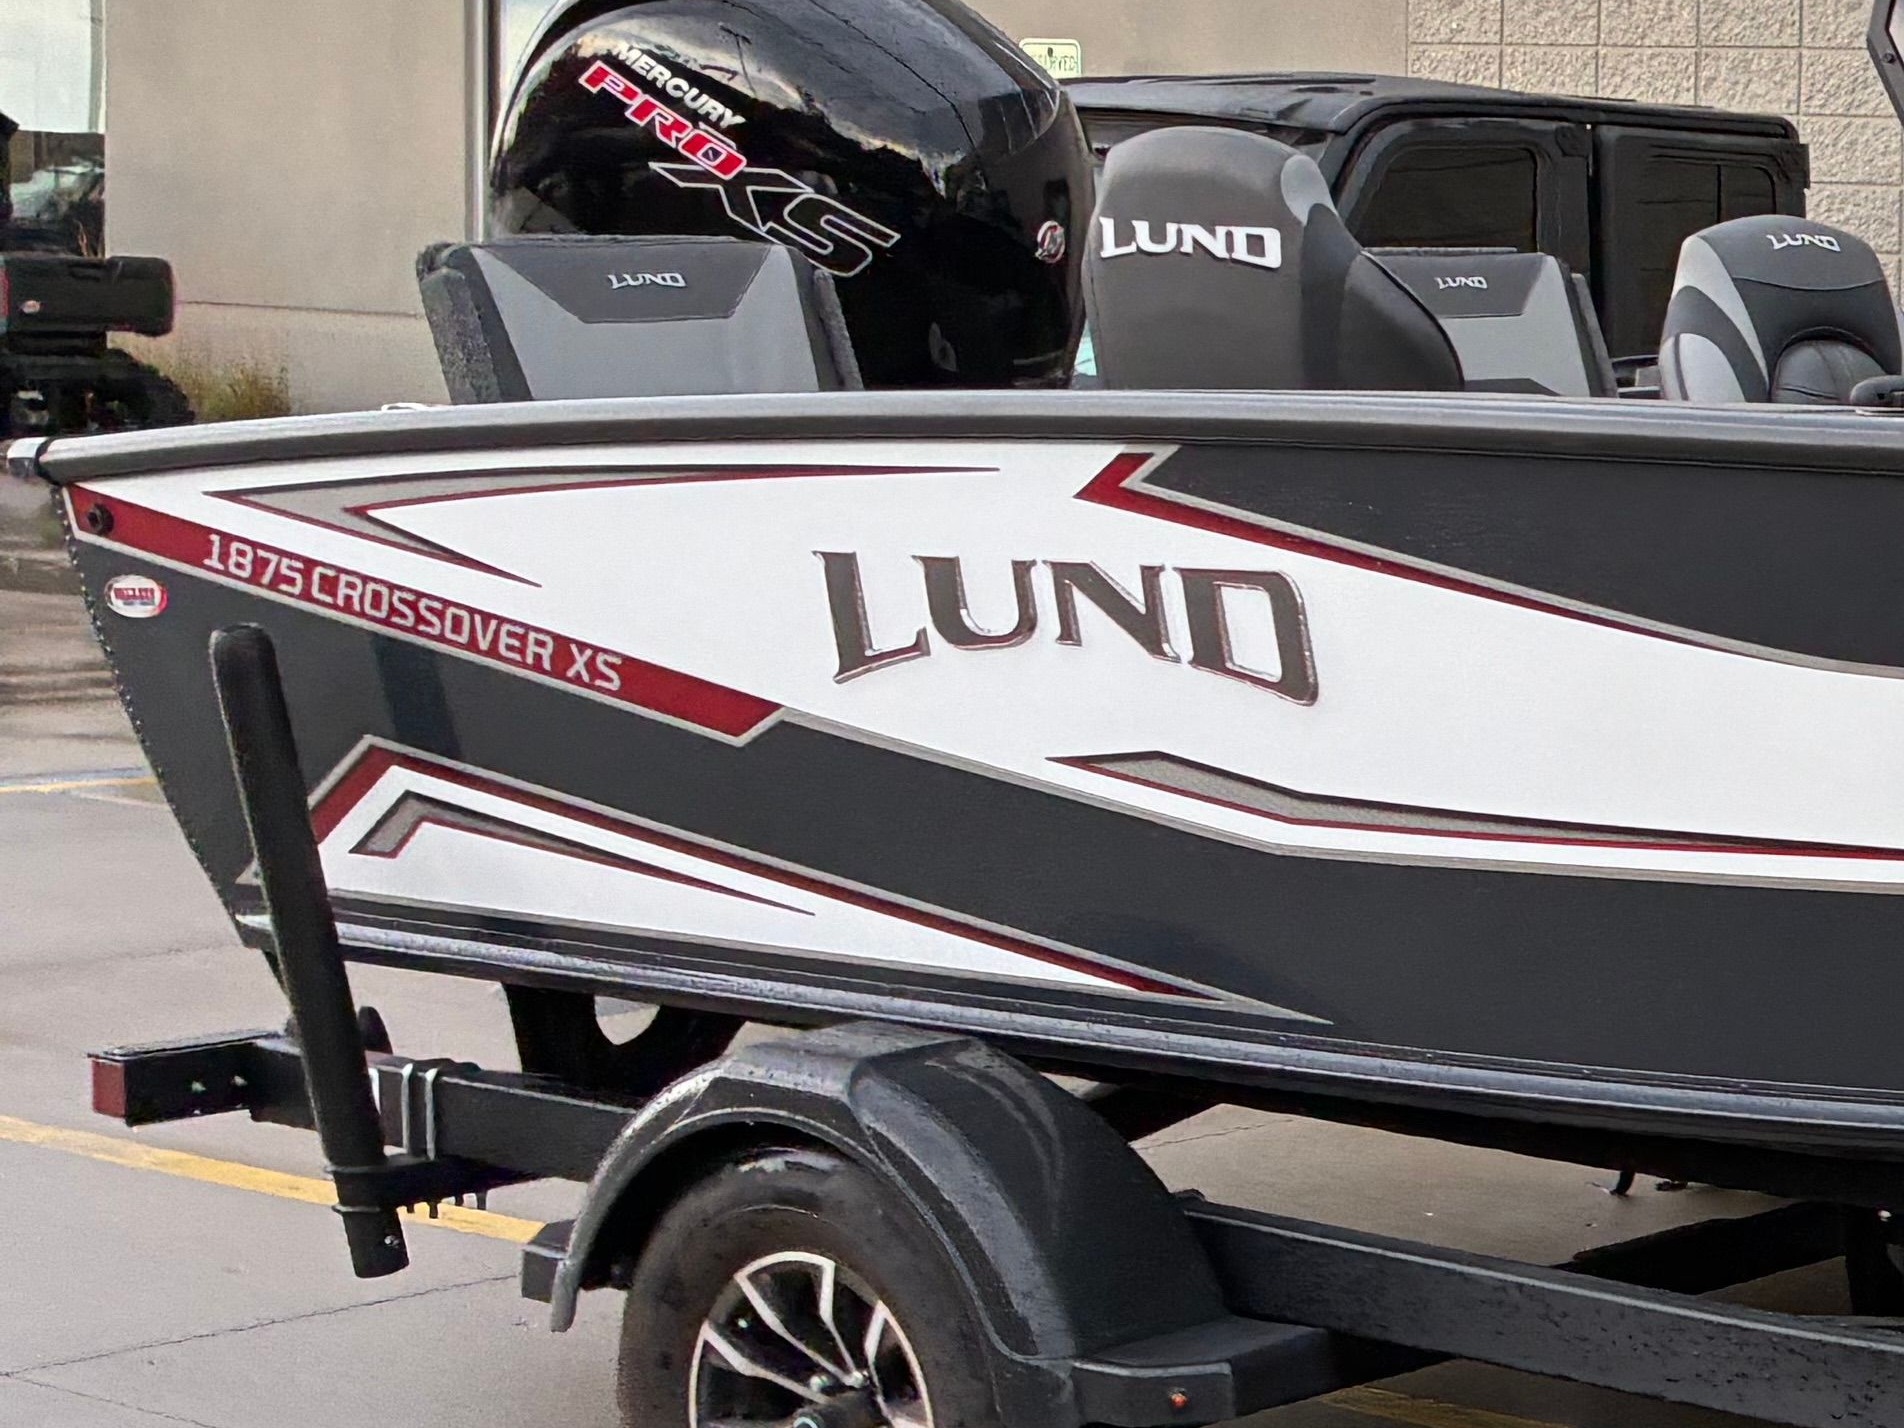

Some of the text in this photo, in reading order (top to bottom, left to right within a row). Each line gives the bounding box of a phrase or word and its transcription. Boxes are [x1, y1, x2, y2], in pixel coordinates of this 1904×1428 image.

[578, 60, 747, 181] PRO
[611, 43, 746, 128] MERCURY
[648, 161, 901, 277] XS
[1098, 215, 1283, 269] LUND
[1765, 233, 1841, 253] LUND
[608, 272, 687, 289] LUND
[1434, 276, 1488, 290] LUND
[202, 534, 622, 692] 1875 CROSSOVER XS
[812, 549, 1320, 708] LUND
